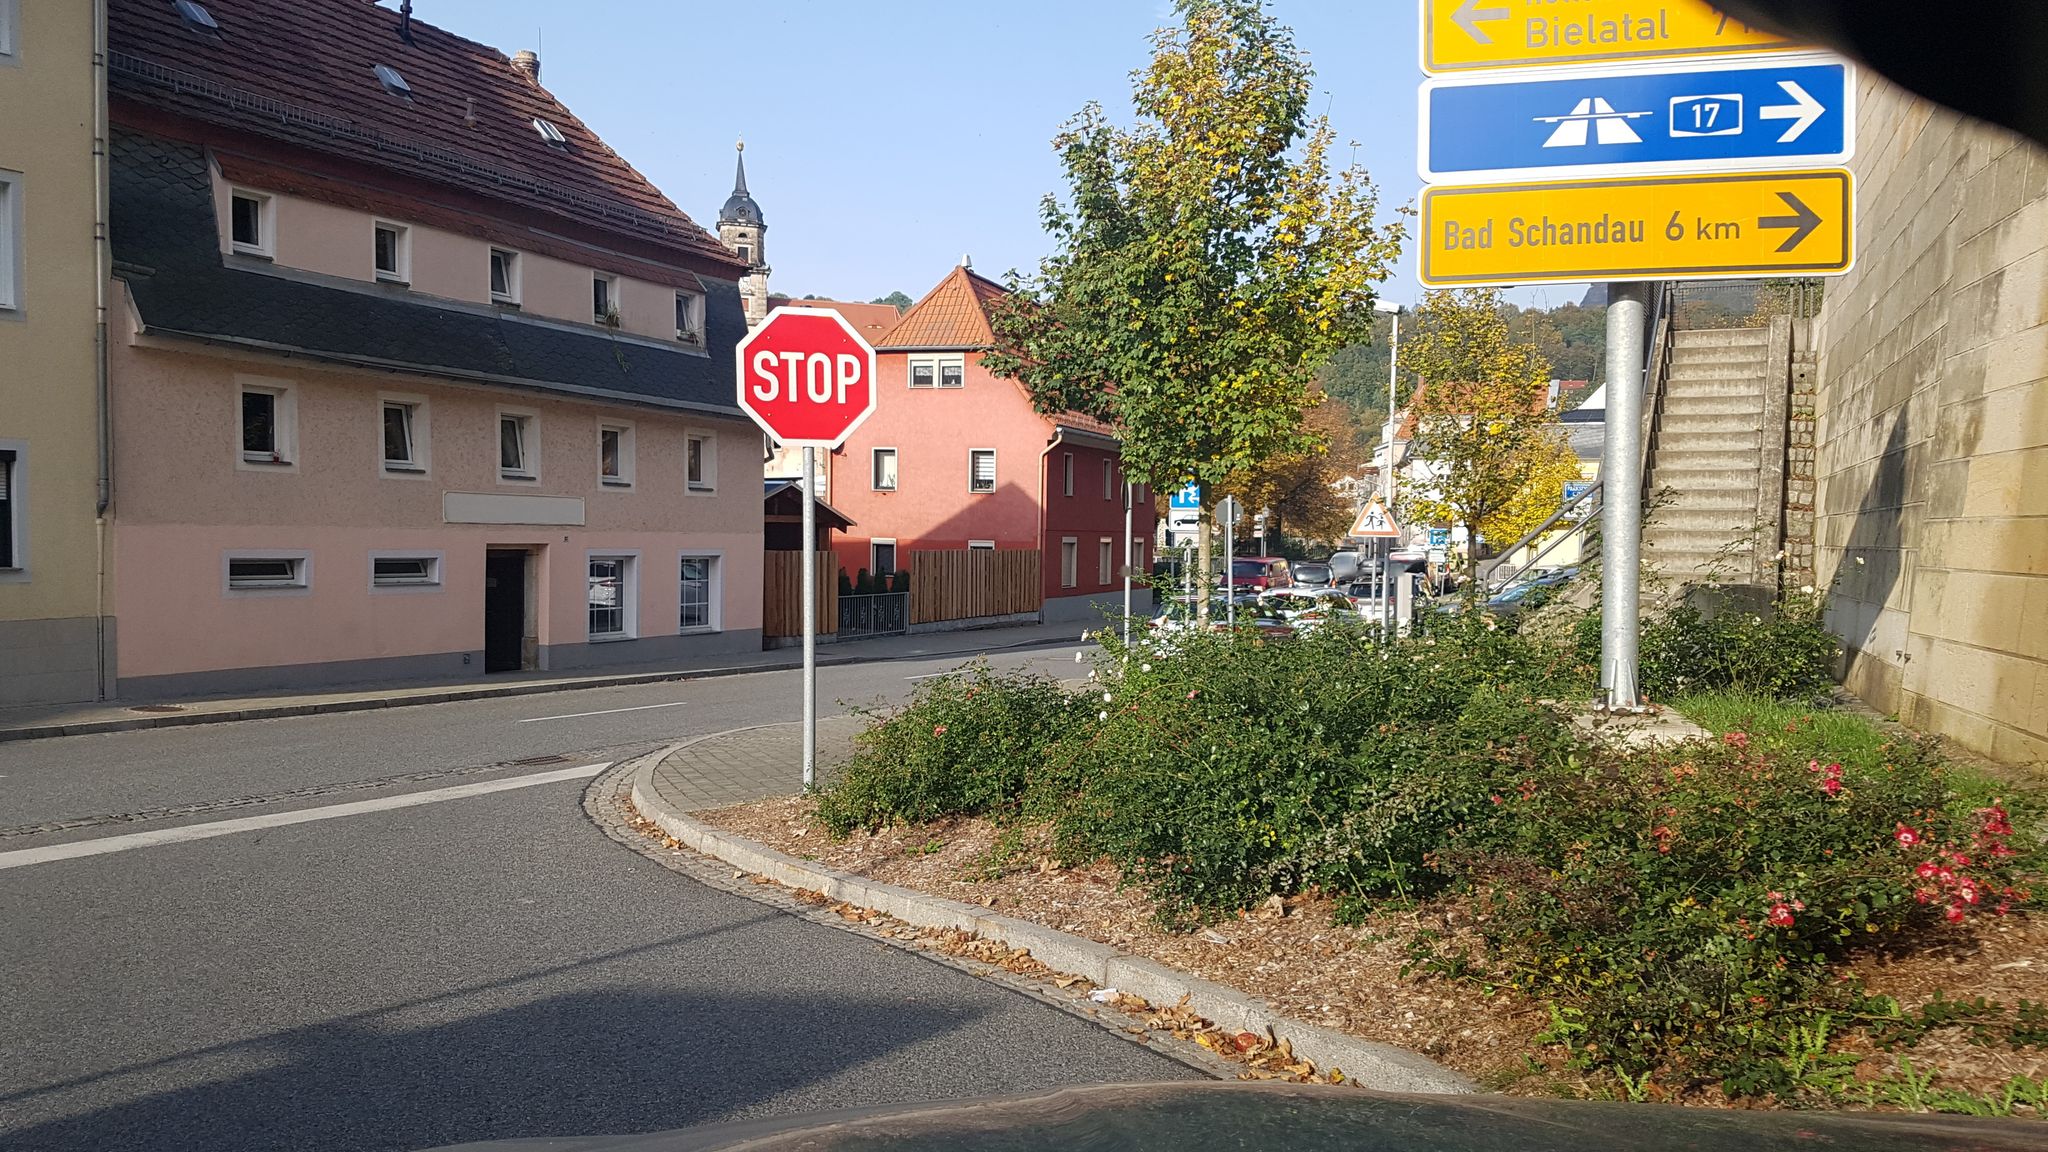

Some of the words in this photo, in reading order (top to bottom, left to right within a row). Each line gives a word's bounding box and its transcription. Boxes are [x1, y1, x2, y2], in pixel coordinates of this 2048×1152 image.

[1526, 8, 1669, 48] Bielatal
[1692, 103, 1720, 128] 17
[1444, 218, 1493, 251] Bad
[1508, 213, 1644, 248] Schandau
[1665, 210, 1685, 241] 6
[1697, 217, 1740, 240] km
[753, 350, 861, 404] STOP
